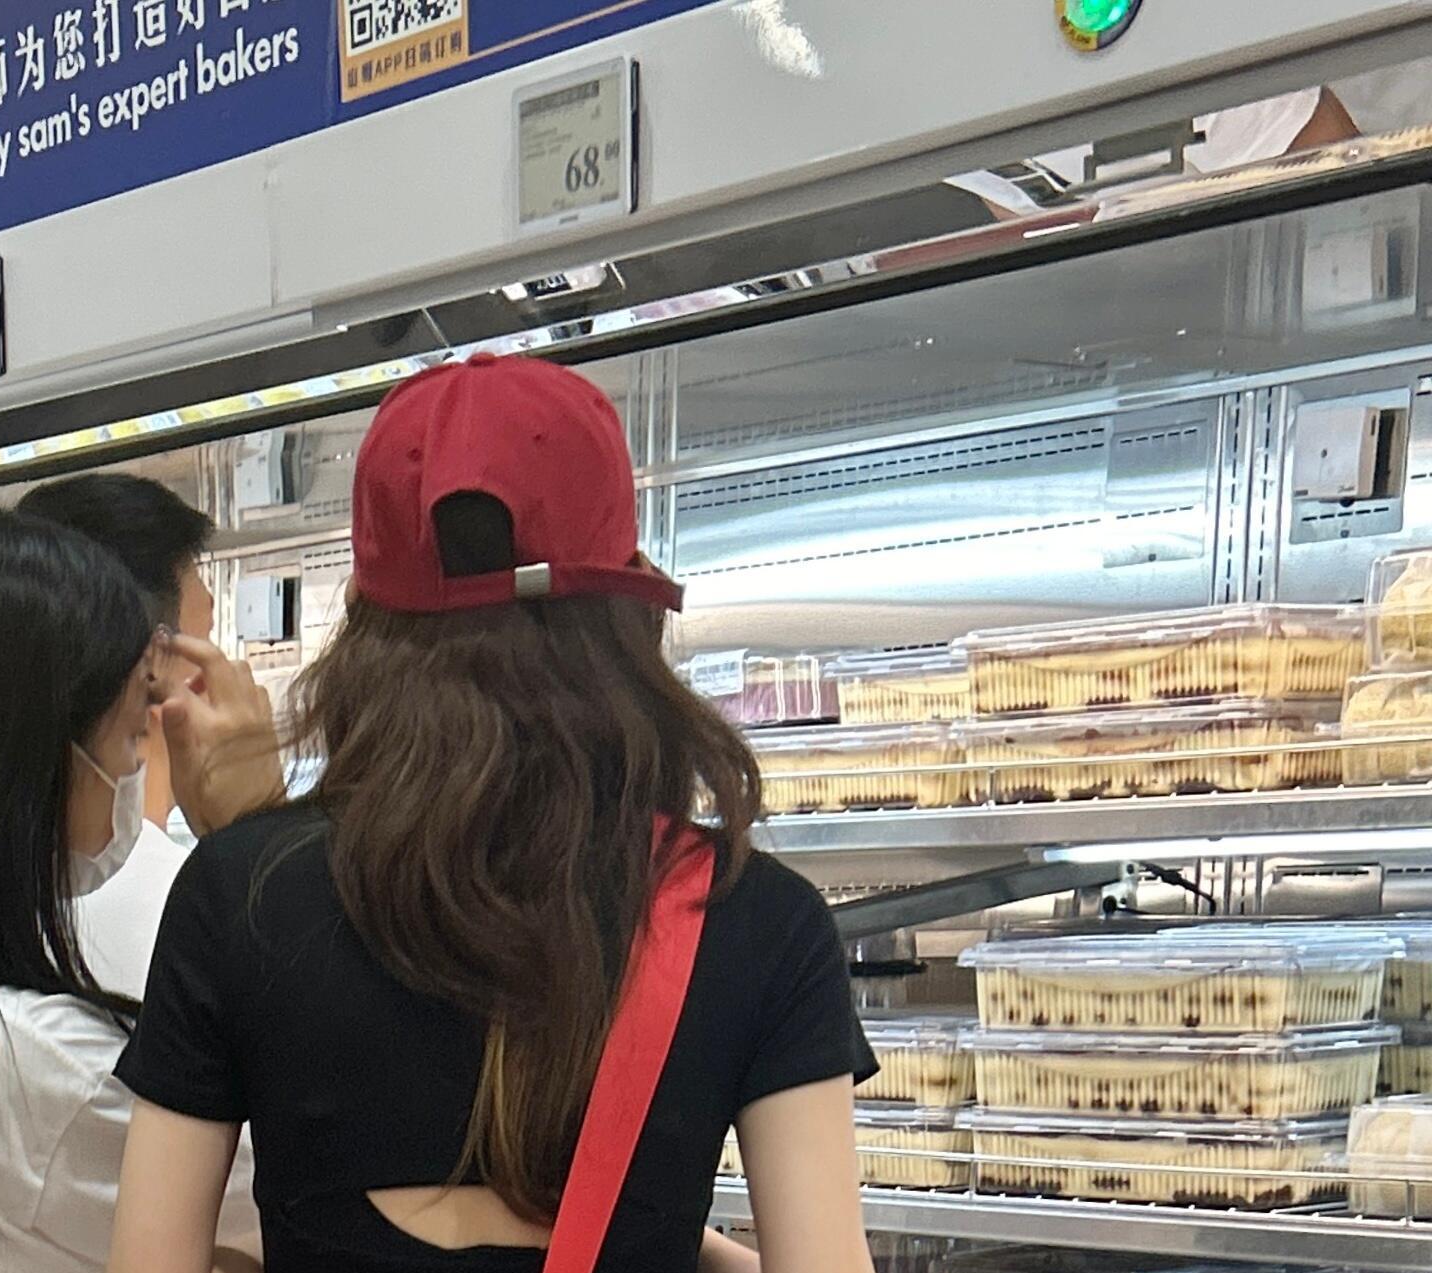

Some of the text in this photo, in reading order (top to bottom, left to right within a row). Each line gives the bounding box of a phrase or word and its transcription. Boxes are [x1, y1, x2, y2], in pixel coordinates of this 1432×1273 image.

[18, 93, 91, 157] sam's
[98, 59, 189, 130] expert
[196, 27, 300, 94] bakers
